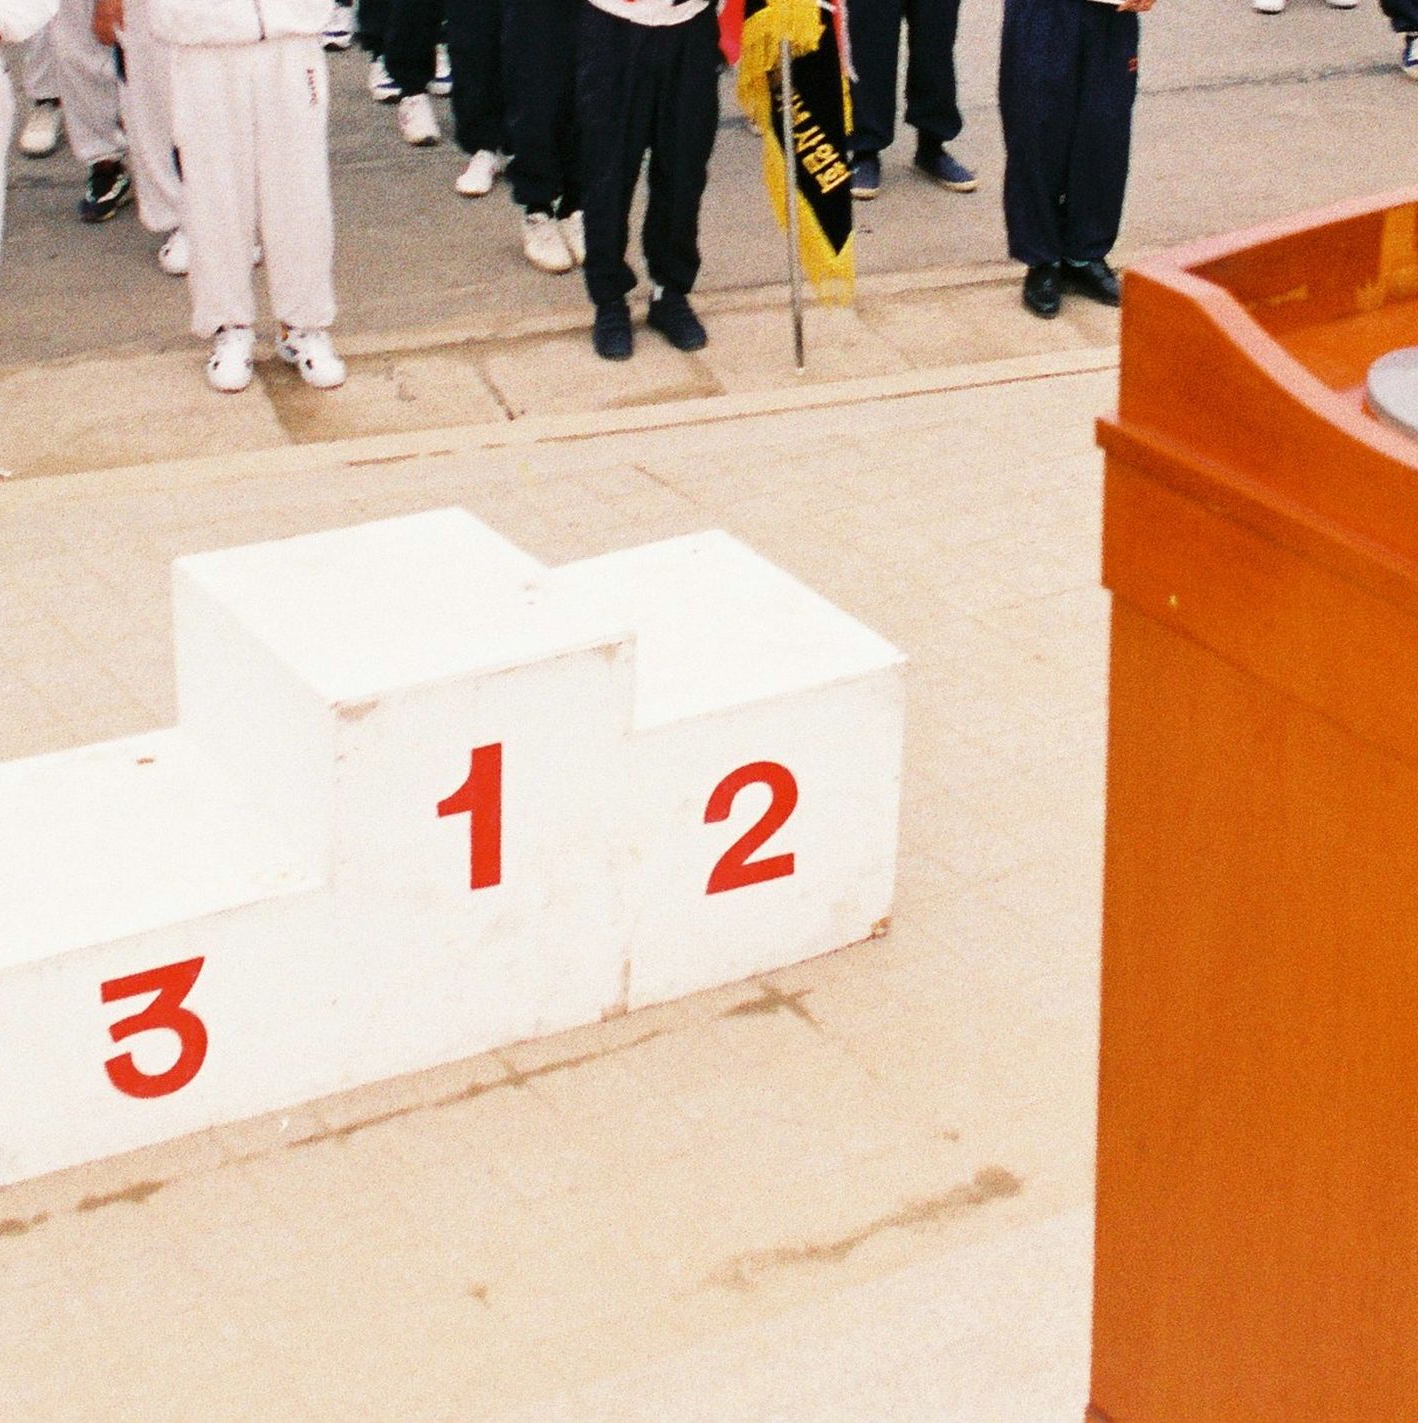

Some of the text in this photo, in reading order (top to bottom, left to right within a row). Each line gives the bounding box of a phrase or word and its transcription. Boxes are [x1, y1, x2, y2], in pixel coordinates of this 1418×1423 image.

[438, 744, 501, 889] 1
[705, 762, 797, 893] 2
[101, 957, 207, 1098] 3
